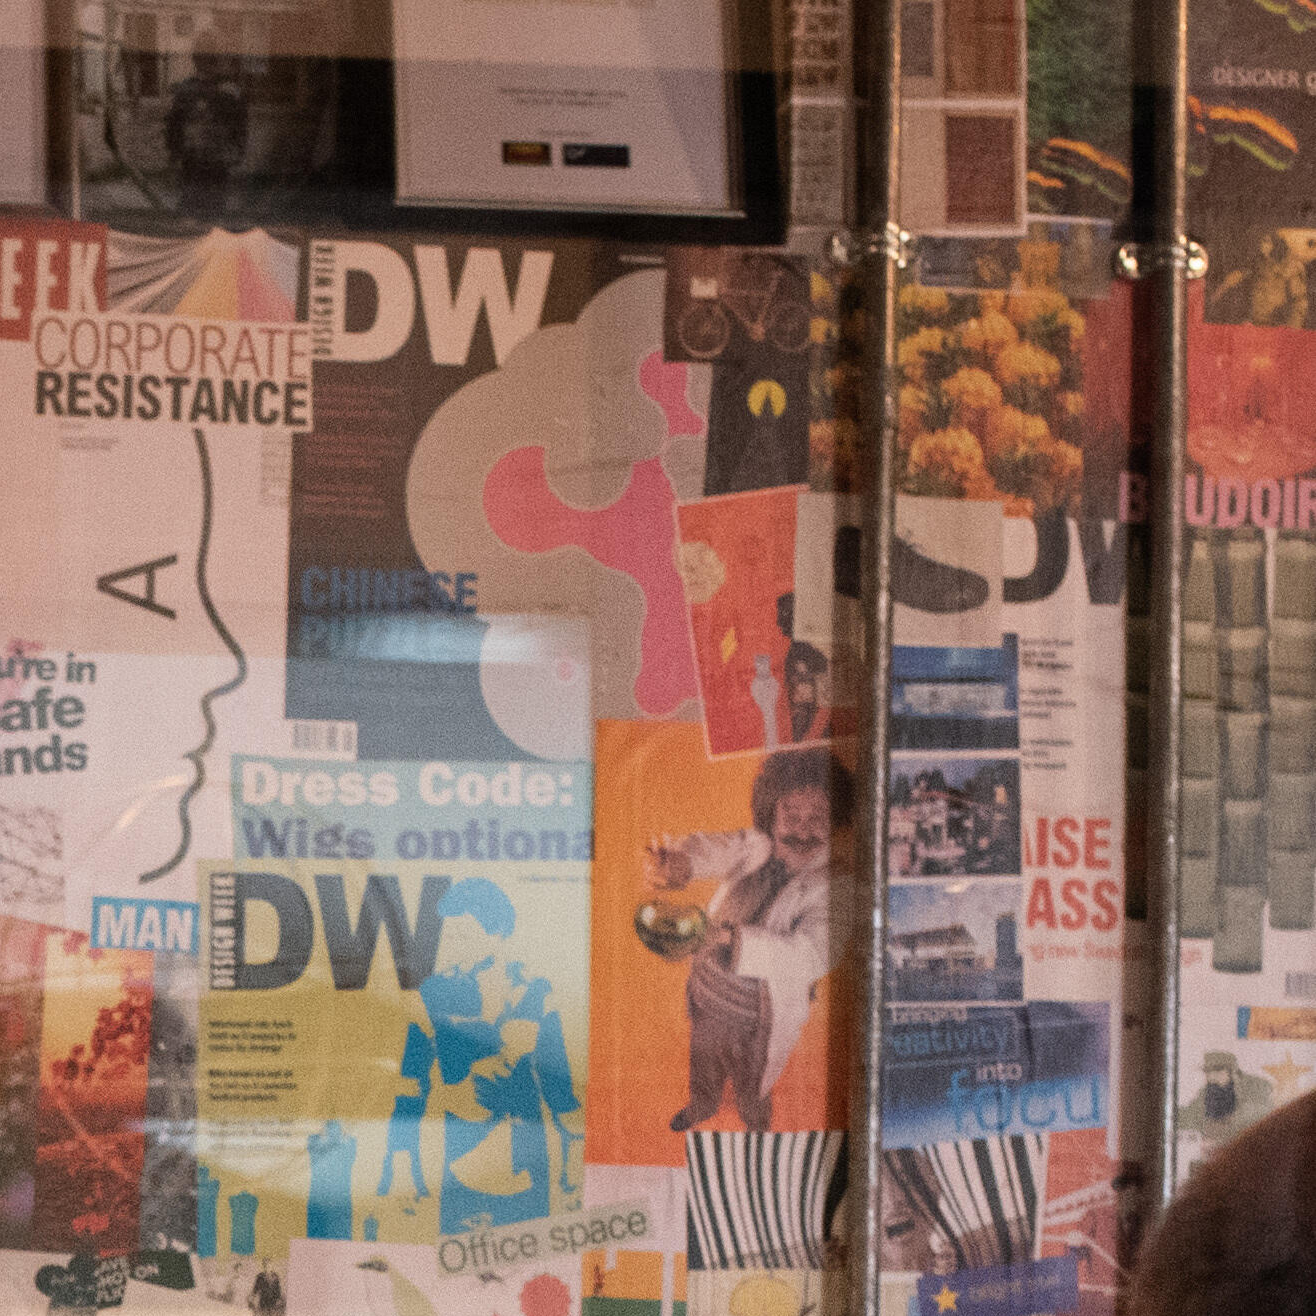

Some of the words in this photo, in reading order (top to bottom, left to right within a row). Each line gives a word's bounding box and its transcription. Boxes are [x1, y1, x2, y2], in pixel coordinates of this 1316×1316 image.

[343, 243, 554, 366] DW
[34, 316, 310, 384] CORPORATE
[34, 371, 308, 429] RESISTANCE
[301, 566, 479, 616] CHINESE
[66, 653, 97, 684] in
[241, 762, 399, 806] Dress
[417, 762, 575, 807] Code:
[242, 818, 377, 863] Wigs
[97, 903, 194, 950] MAN
[231, 871, 453, 990] DW
[976, 1061, 1022, 1081] into
[440, 1231, 539, 1277] Office
[549, 1209, 647, 1253] space
